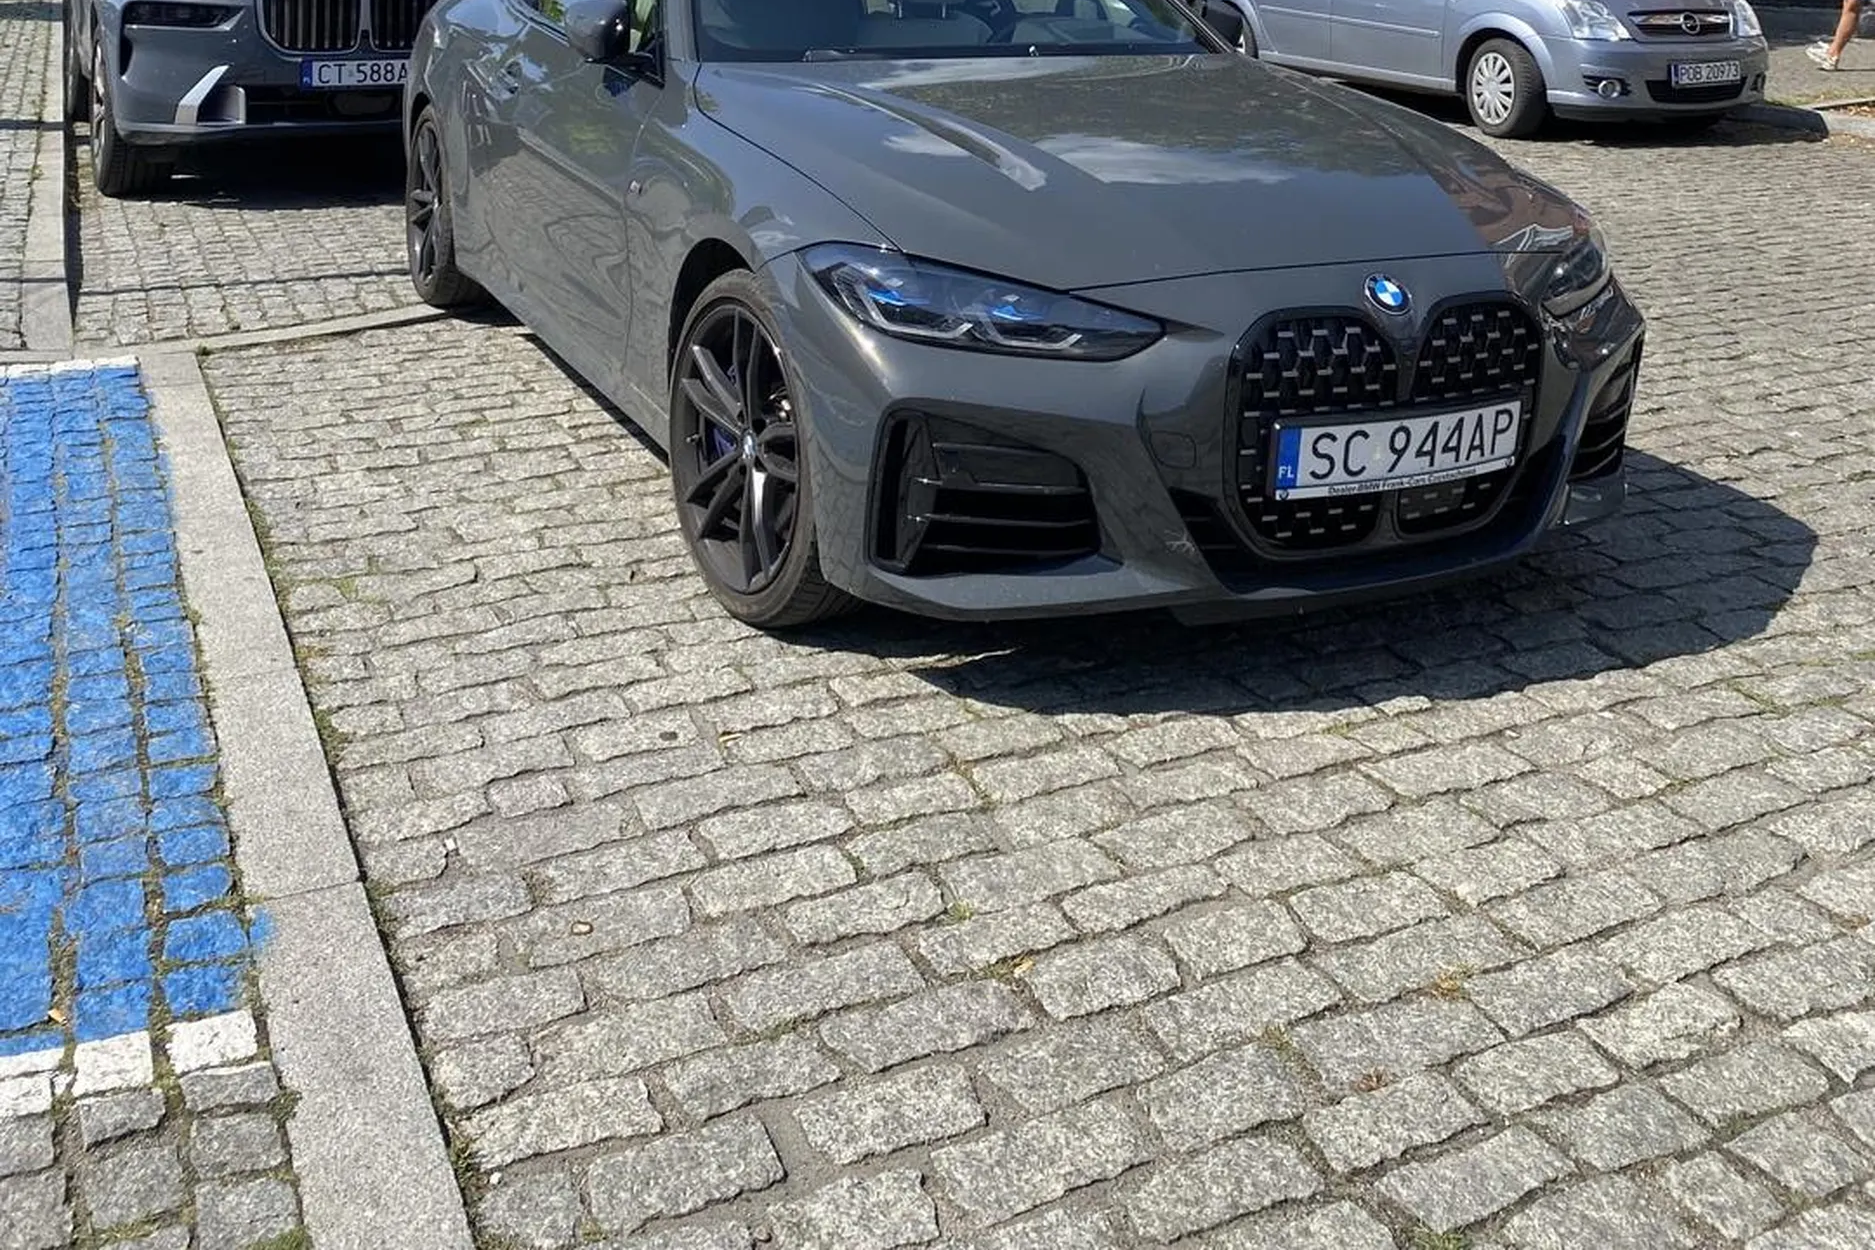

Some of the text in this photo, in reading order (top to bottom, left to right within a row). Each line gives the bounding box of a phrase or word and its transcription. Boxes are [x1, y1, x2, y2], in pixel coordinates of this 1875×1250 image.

[318, 62, 408, 84] CT 588A
[1309, 408, 1514, 481] SC 944AP
